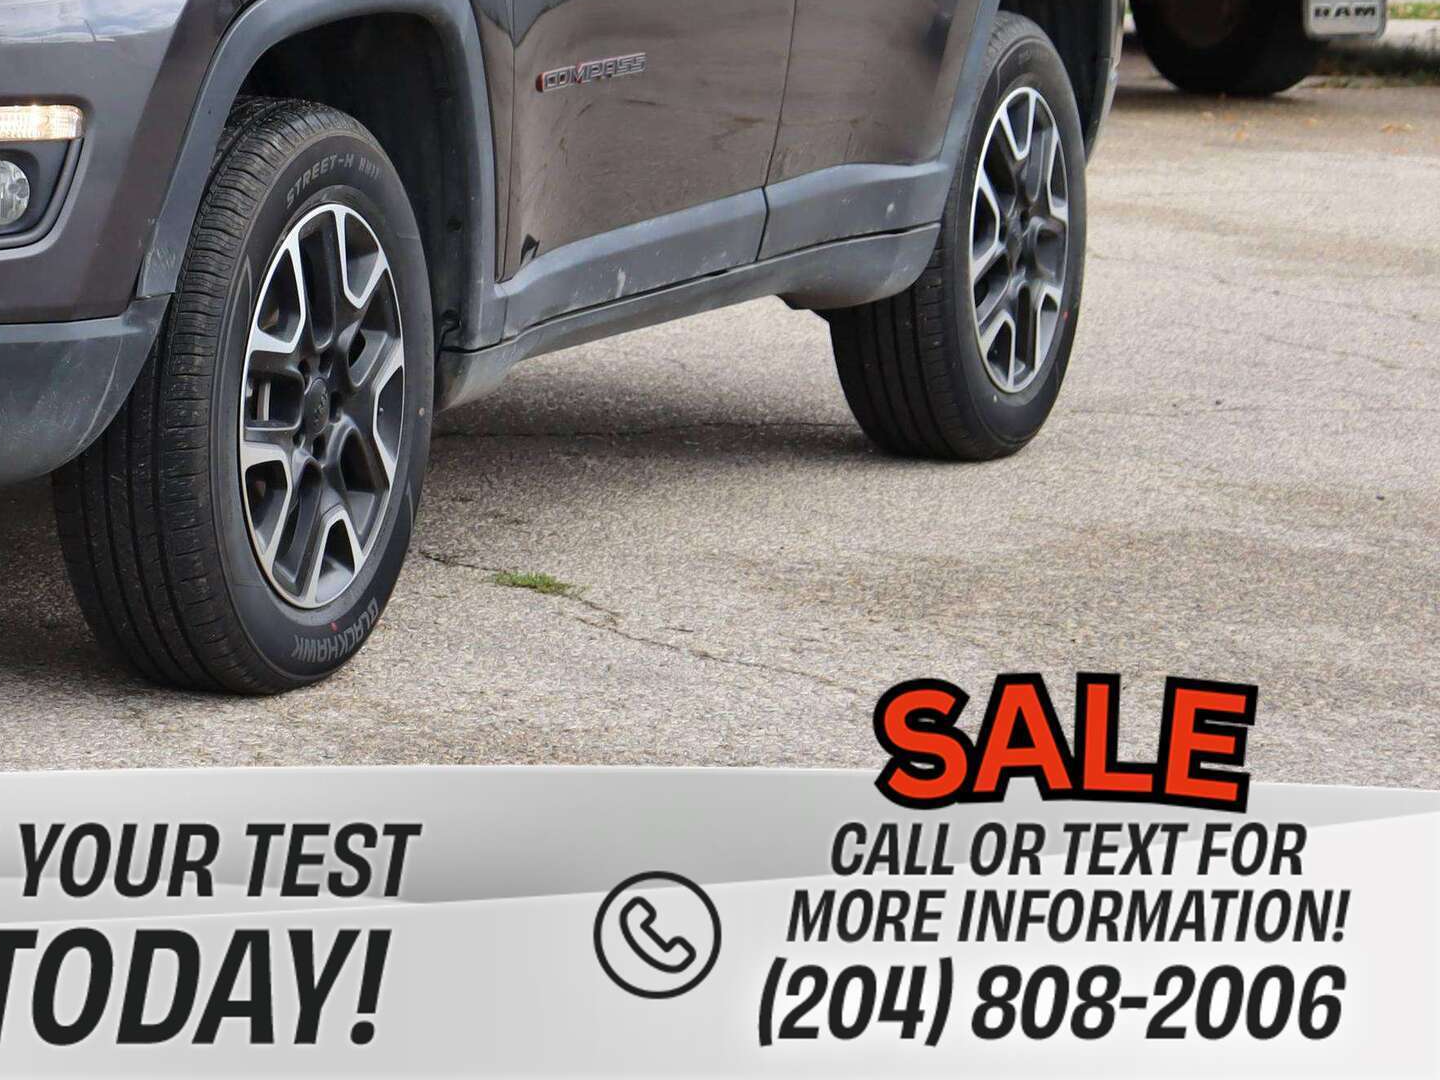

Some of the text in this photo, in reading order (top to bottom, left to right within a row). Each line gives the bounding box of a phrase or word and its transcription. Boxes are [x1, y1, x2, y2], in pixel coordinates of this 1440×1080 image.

[1313, 4, 1377, 17] RAM
[537, 52, 647, 93] COMPASS
[291, 597, 379, 663] BLACKHAWK
